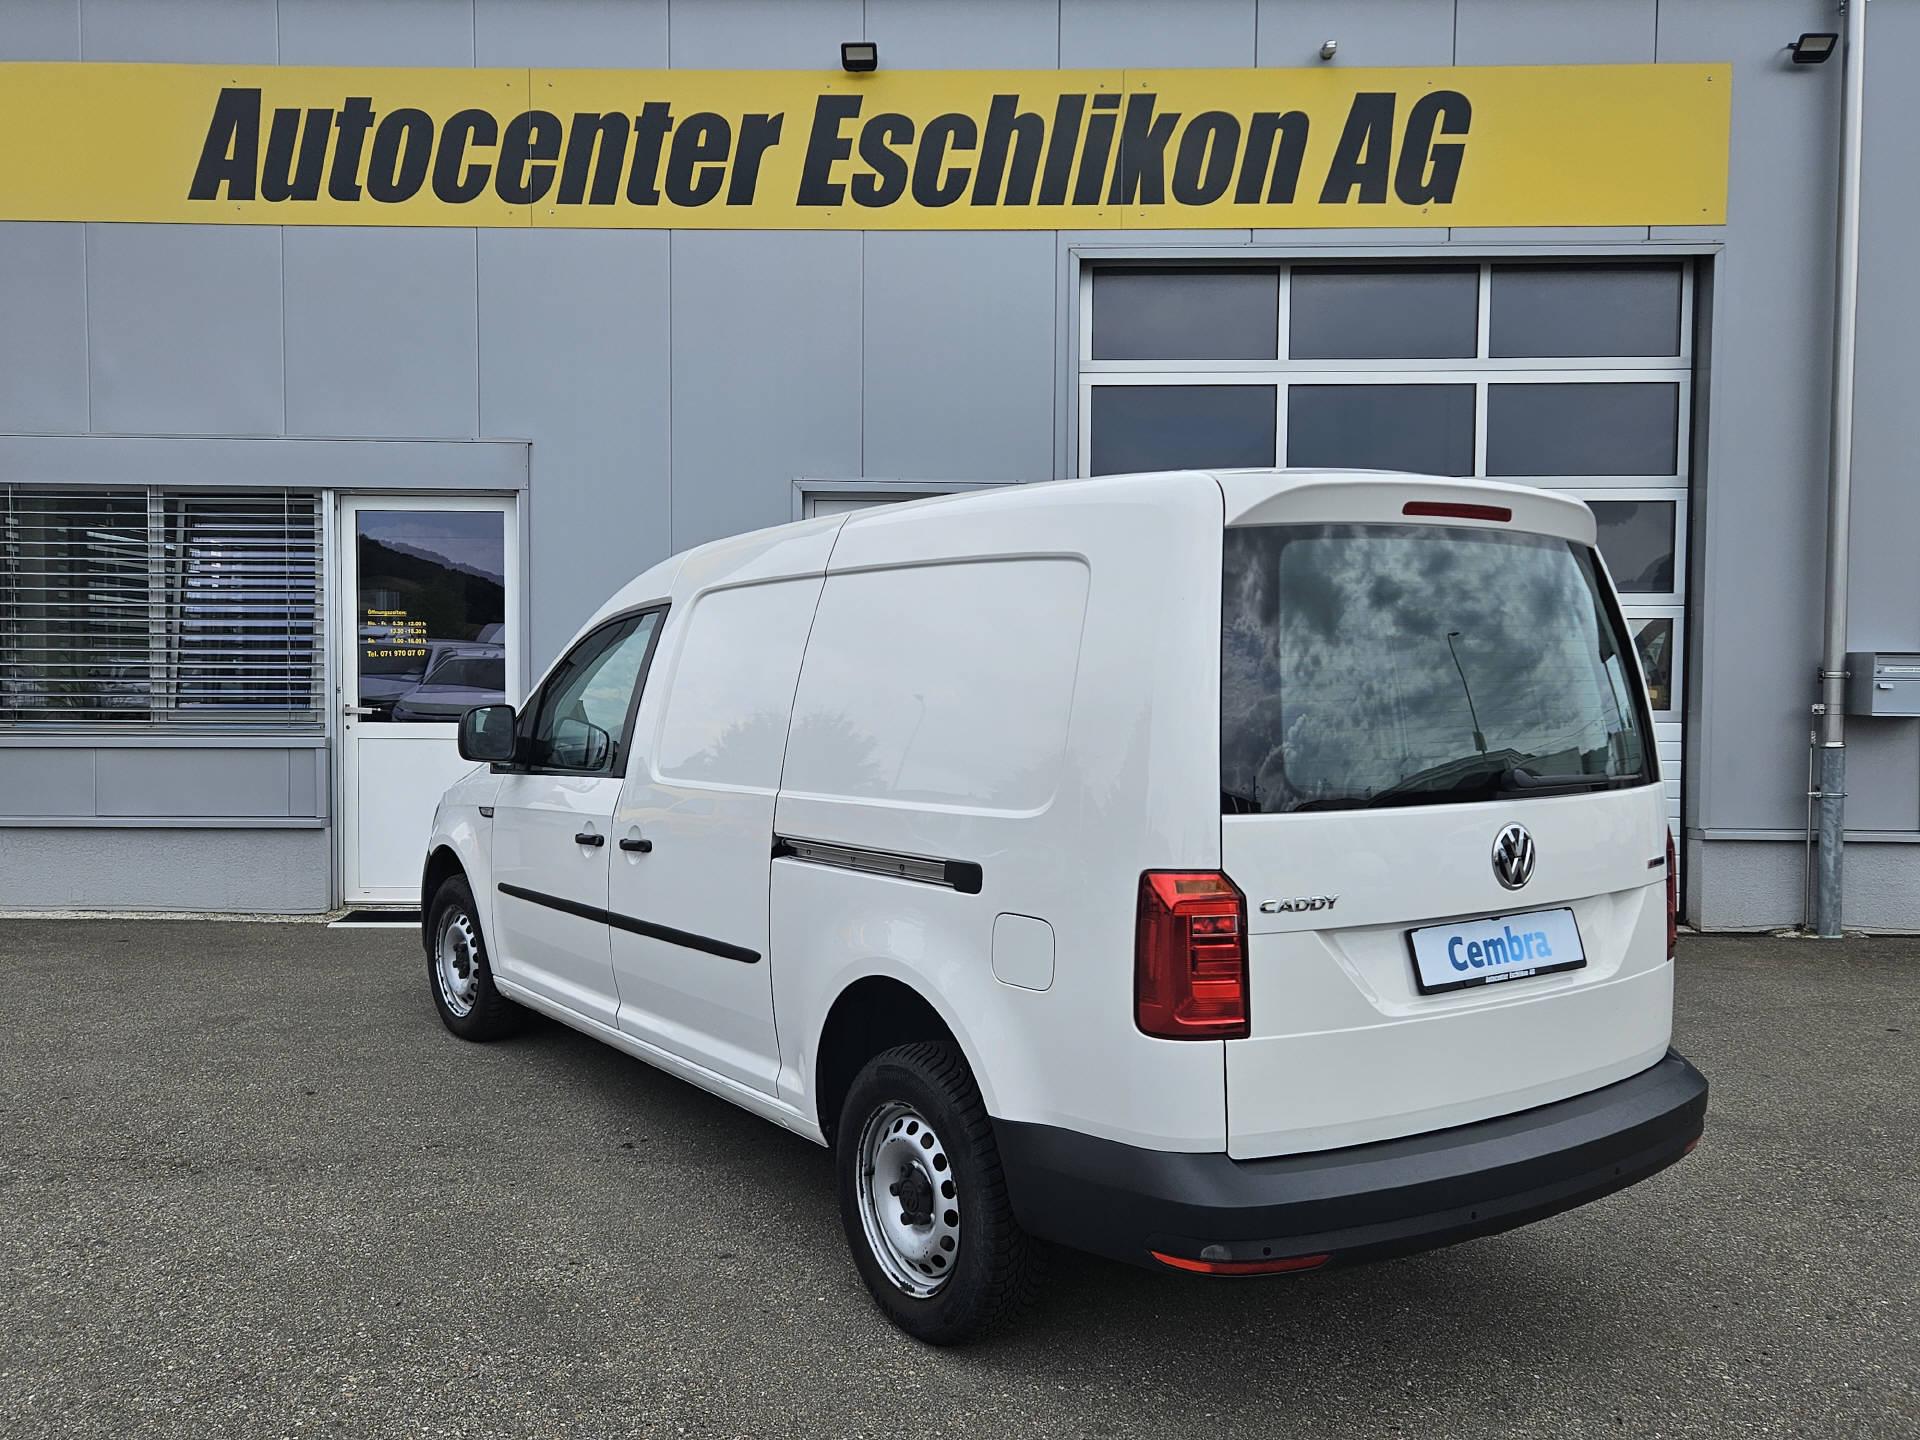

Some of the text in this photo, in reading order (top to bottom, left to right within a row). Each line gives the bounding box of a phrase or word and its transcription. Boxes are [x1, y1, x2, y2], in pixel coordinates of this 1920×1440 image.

[188, 88, 1472, 207] Autocenter Eschlikon AG
[367, 650, 379, 658] Tel.
[407, 649, 416, 657] 07
[1259, 894, 1340, 914] CADDY
[1448, 925, 1552, 971] Cembra
